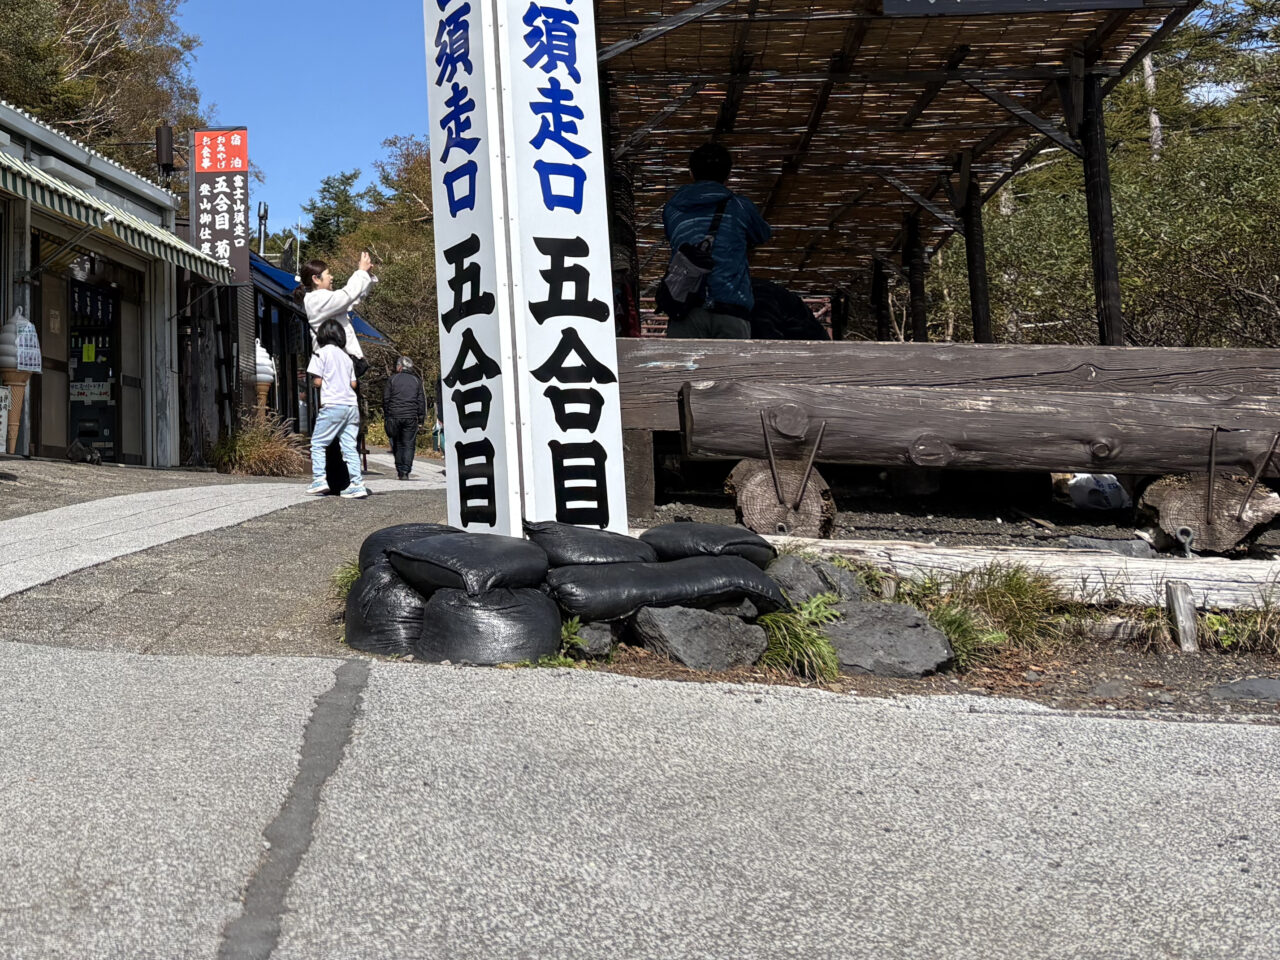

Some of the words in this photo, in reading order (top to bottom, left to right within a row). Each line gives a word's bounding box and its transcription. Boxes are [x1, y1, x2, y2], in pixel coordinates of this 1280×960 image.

[201, 136, 212, 169] お食事
[216, 136, 226, 169] おみやげ
[230, 134, 242, 168] 宿泊
[213, 176, 231, 230] 五合目
[233, 175, 245, 248] 富士山須走口
[441, 233, 502, 528] 五合目
[528, 236, 617, 529] 五合目
